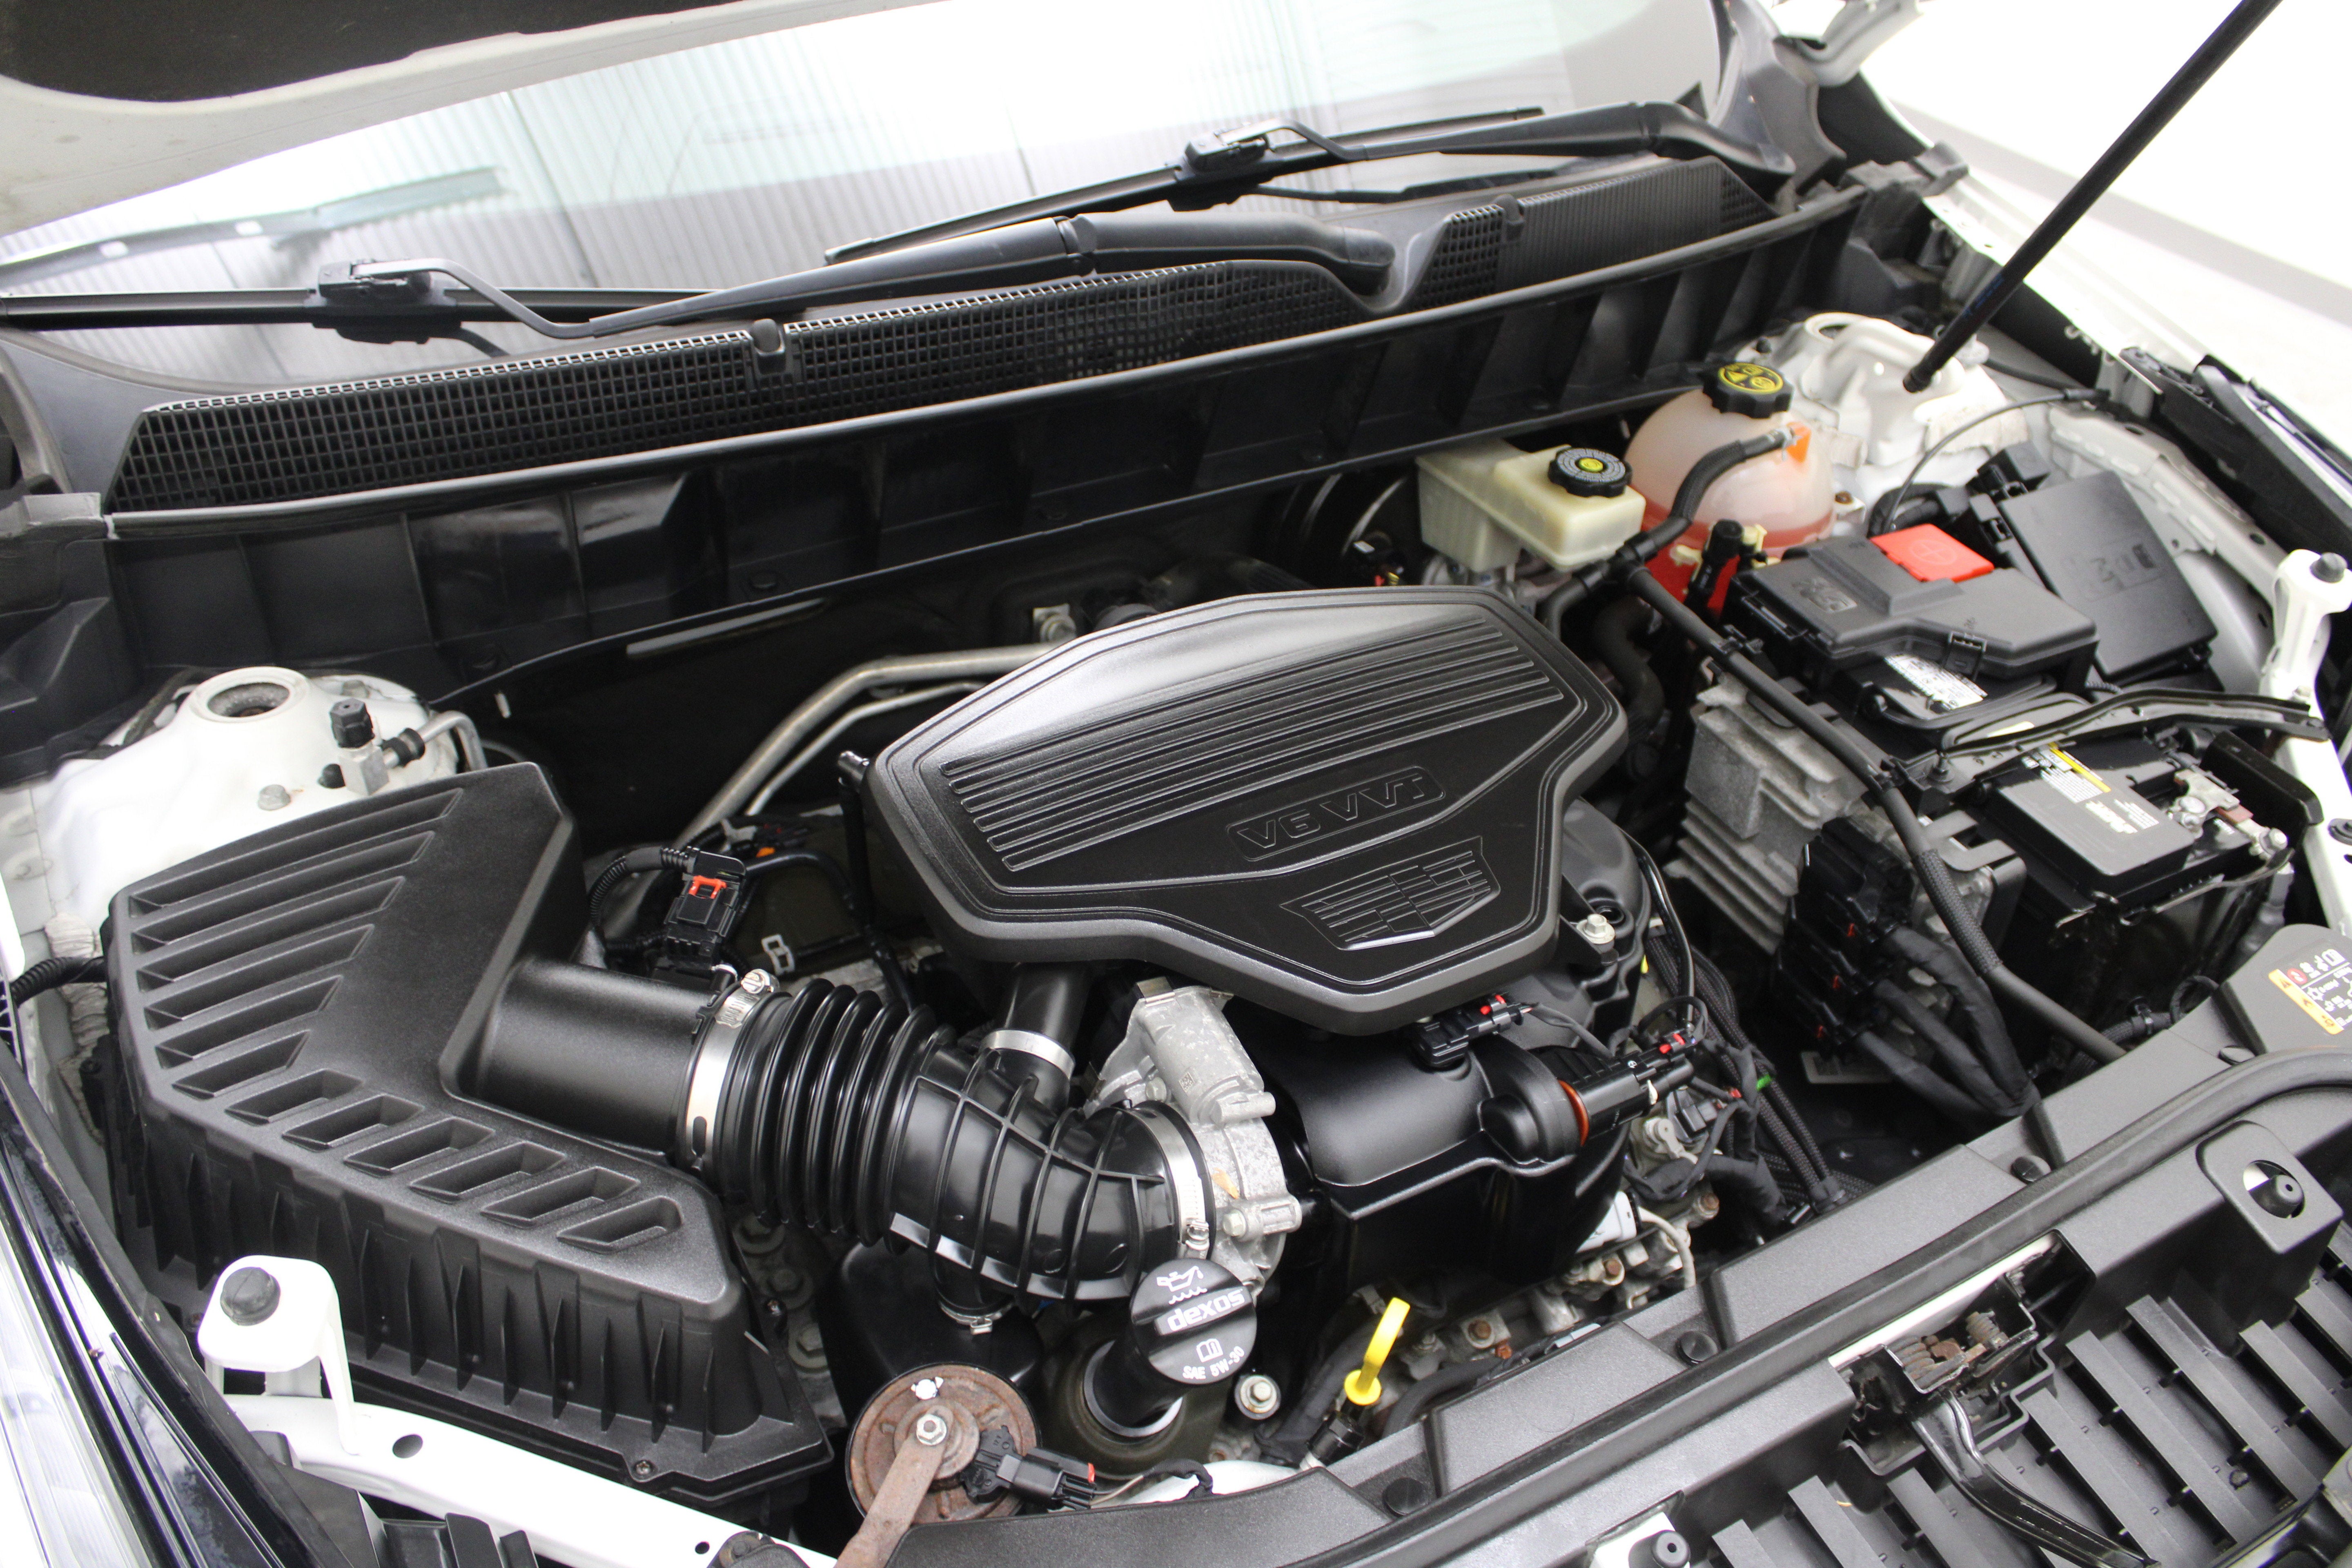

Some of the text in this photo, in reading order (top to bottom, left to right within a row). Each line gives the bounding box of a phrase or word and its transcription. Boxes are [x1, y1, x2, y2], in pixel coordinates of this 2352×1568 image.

[1237, 773, 1425, 849] V6 VVT
[1167, 1289, 1245, 1332] dexos
[1182, 1346, 1245, 1380] SAE 5W-30
